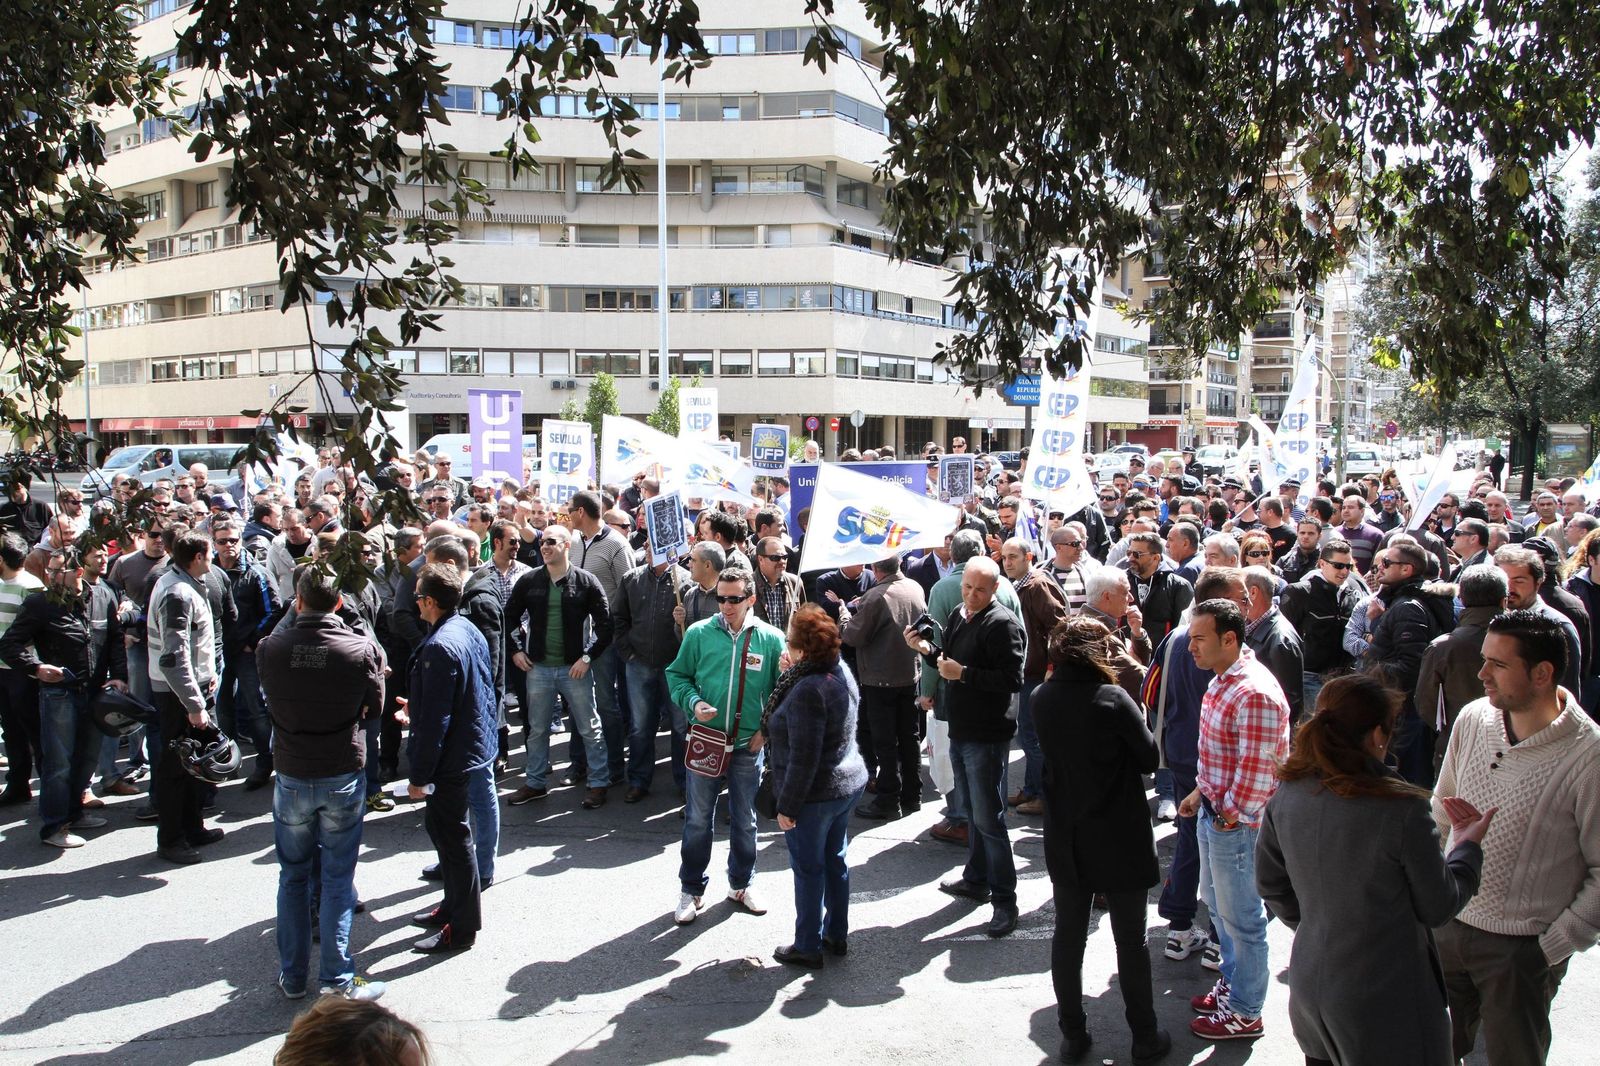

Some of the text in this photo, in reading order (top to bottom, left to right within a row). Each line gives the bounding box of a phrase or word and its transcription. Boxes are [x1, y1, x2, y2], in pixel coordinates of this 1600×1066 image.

[686, 397, 712, 407] SEVILLA
[1048, 392, 1079, 416] CEP
[687, 412, 713, 430] CEP
[549, 432, 583, 446] SEVILLA
[1042, 429, 1075, 452] CEP
[548, 451, 582, 473] CEP
[753, 447, 785, 461] UFP
[753, 461, 783, 469] SEVILLA
[1034, 465, 1071, 488] CEP
